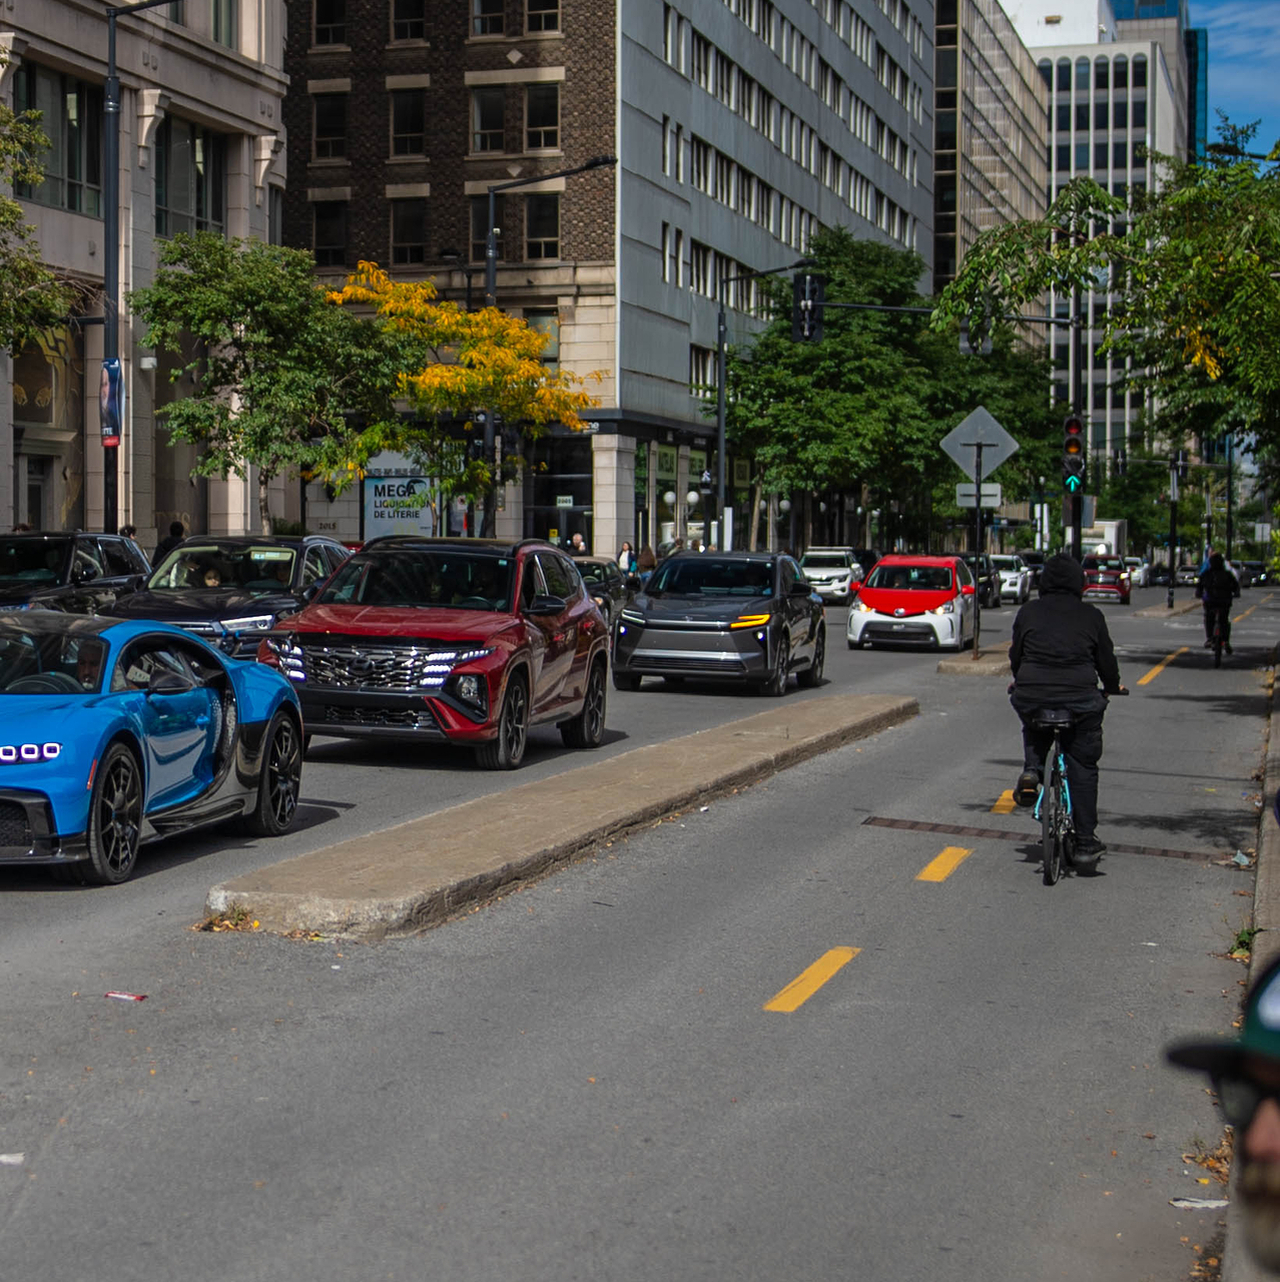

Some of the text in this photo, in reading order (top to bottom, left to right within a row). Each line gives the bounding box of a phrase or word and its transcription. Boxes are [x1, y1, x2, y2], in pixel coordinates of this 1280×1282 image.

[374, 484, 416, 497] MEGA
[374, 500, 431, 509] LIQUIDAON
[374, 510, 420, 518] DE LITERIE
